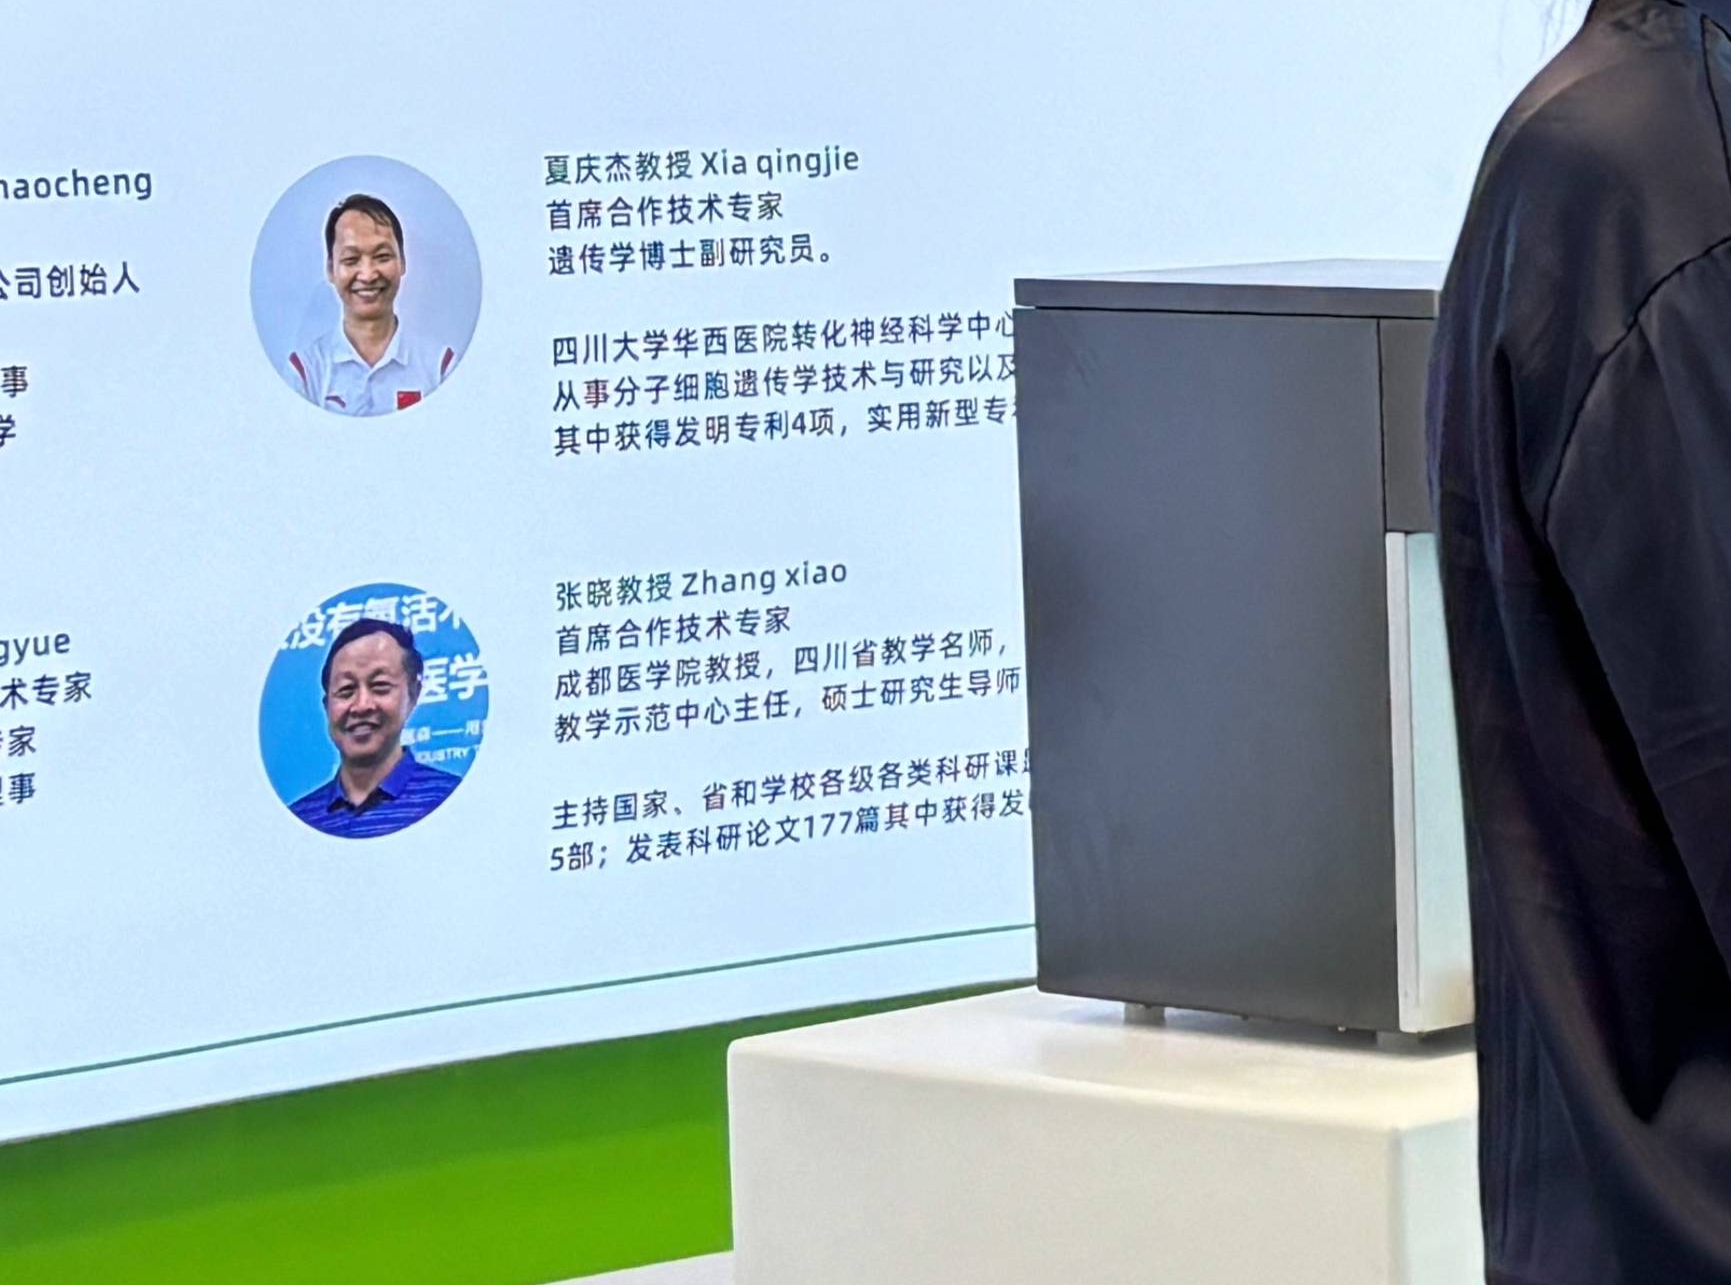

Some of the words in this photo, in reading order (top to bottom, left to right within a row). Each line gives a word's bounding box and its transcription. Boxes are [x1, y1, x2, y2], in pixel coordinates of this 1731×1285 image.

[545, 149, 693, 186] 夏庆杰教授
[699, 149, 748, 176] Xia
[755, 144, 860, 178] qingjie
[546, 191, 783, 231] 首席合作技术专家
[547, 233, 831, 275] 遗传学博士副研究员。
[552, 311, 1014, 365] 四川大学华西医院转化神经科学中心
[1, 365, 28, 398] 事
[553, 397, 1014, 456] 其中获得发明专利4项，实用新型专
[556, 573, 671, 610] 张晓教授
[681, 566, 776, 600] Zhang
[785, 560, 847, 586] xiao
[557, 605, 790, 654] 首席合作技术专家
[556, 628, 1007, 699] 成都医学院教授，四川省教学名师，
[554, 666, 1020, 743] 教学示范中心主任，硕士研究生导师
[0, 725, 36, 757] 家
[0, 772, 36, 805] 事
[552, 748, 1030, 830] 主持国家、省和学校各级各类科研课
